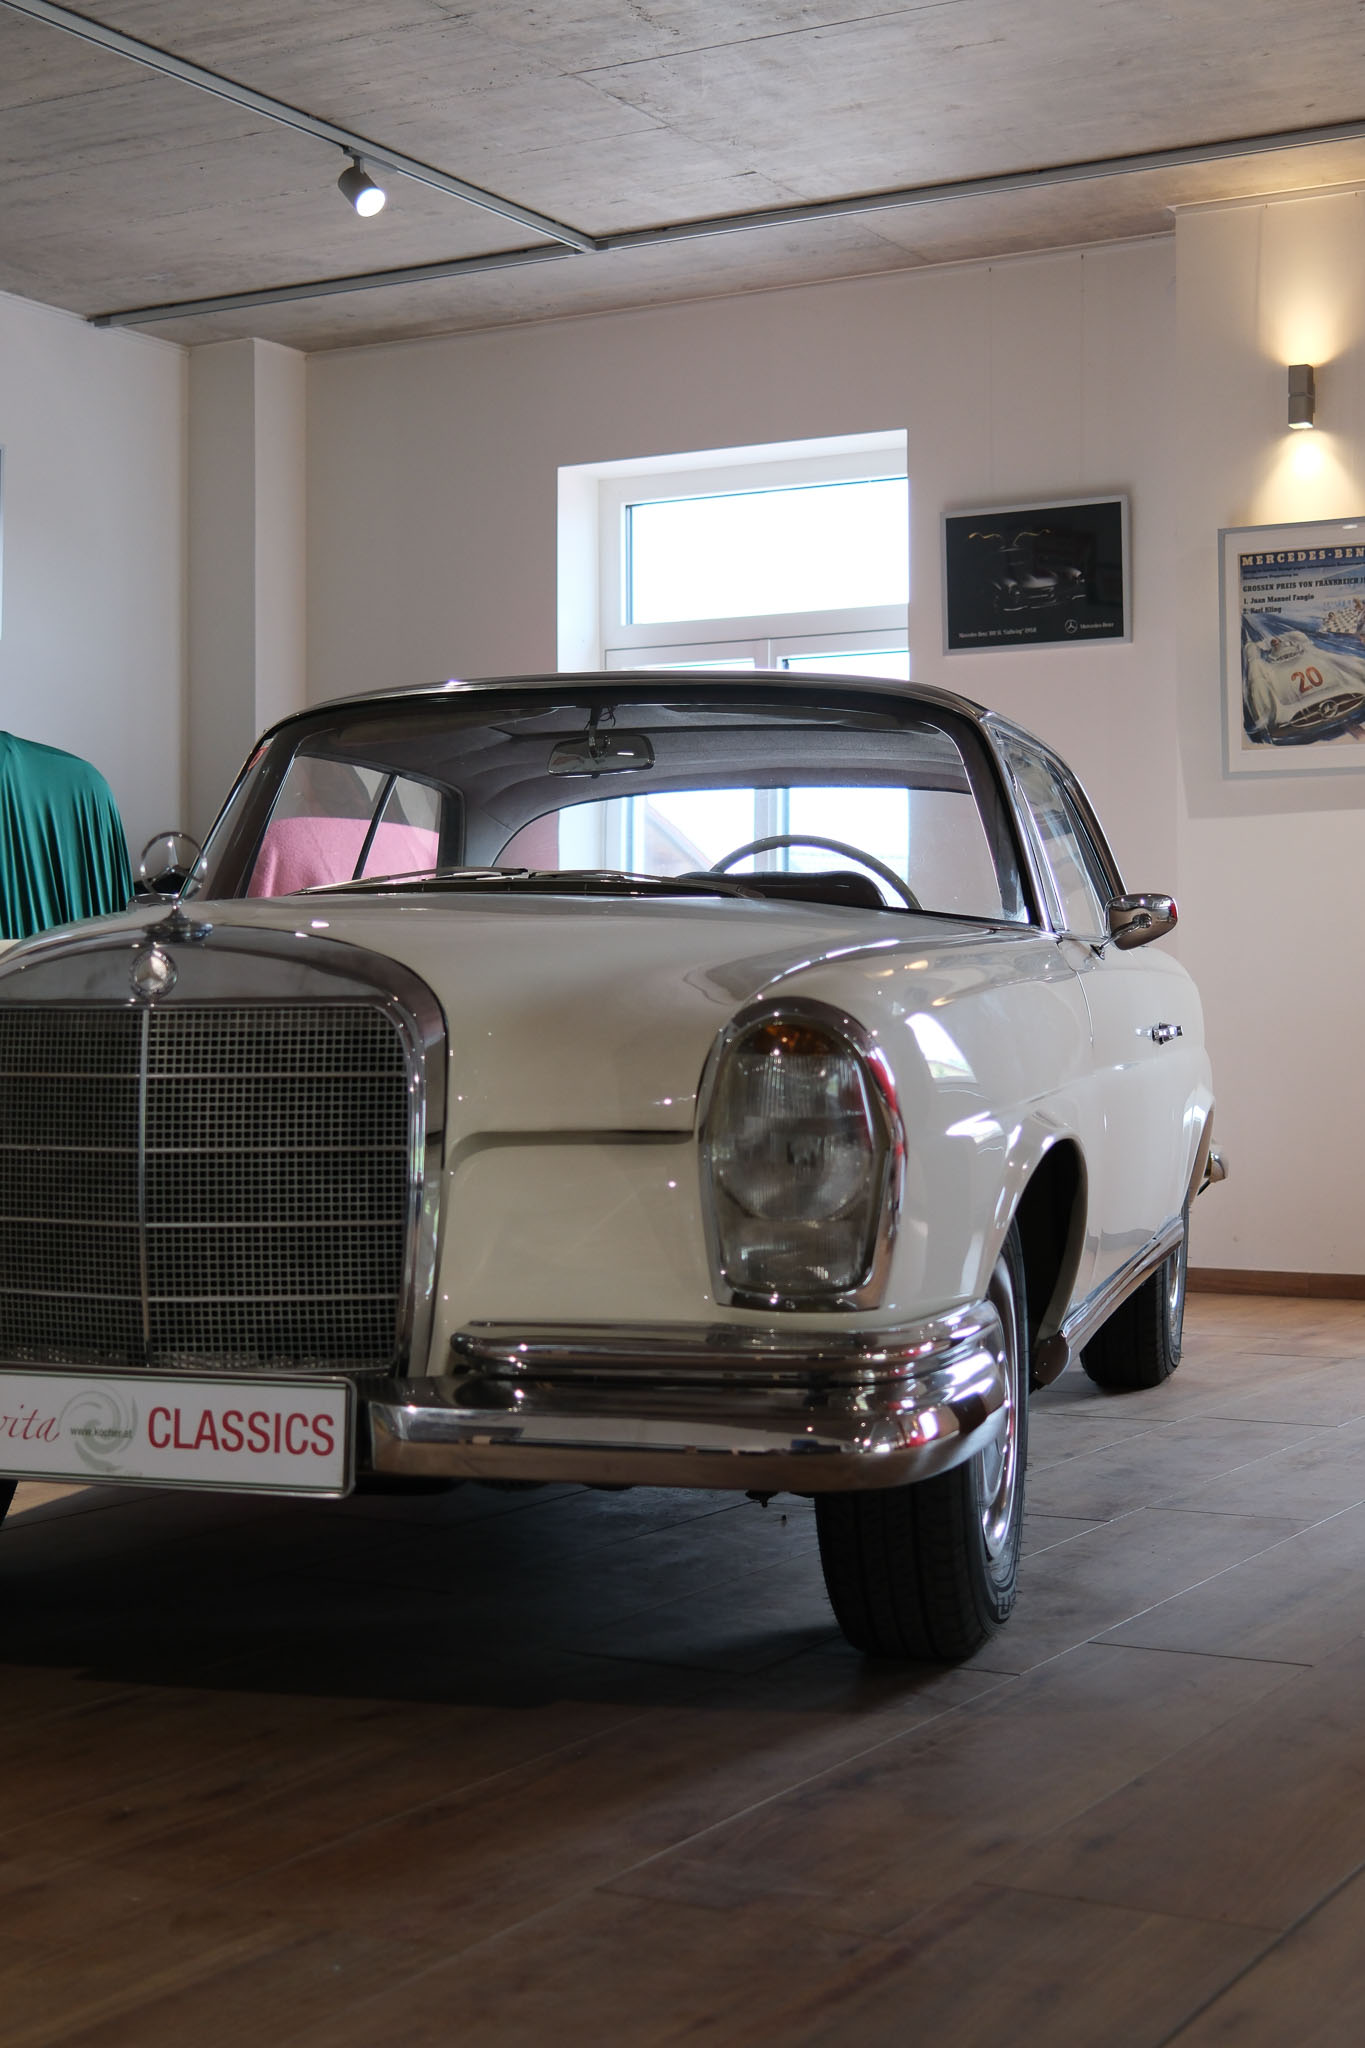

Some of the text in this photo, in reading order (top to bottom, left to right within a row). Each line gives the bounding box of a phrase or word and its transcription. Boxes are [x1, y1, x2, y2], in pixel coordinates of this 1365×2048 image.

[1243, 584, 1274, 593] GROSSEN
[1276, 582, 1297, 590] PREIS
[1299, 580, 1313, 588] VON
[1250, 596, 1266, 605] Juan
[1267, 594, 1291, 603] Manuel
[1293, 593, 1315, 602] Fangio
[1290, 666, 1324, 694] 20
[147, 1406, 335, 1457] CLASSICS
